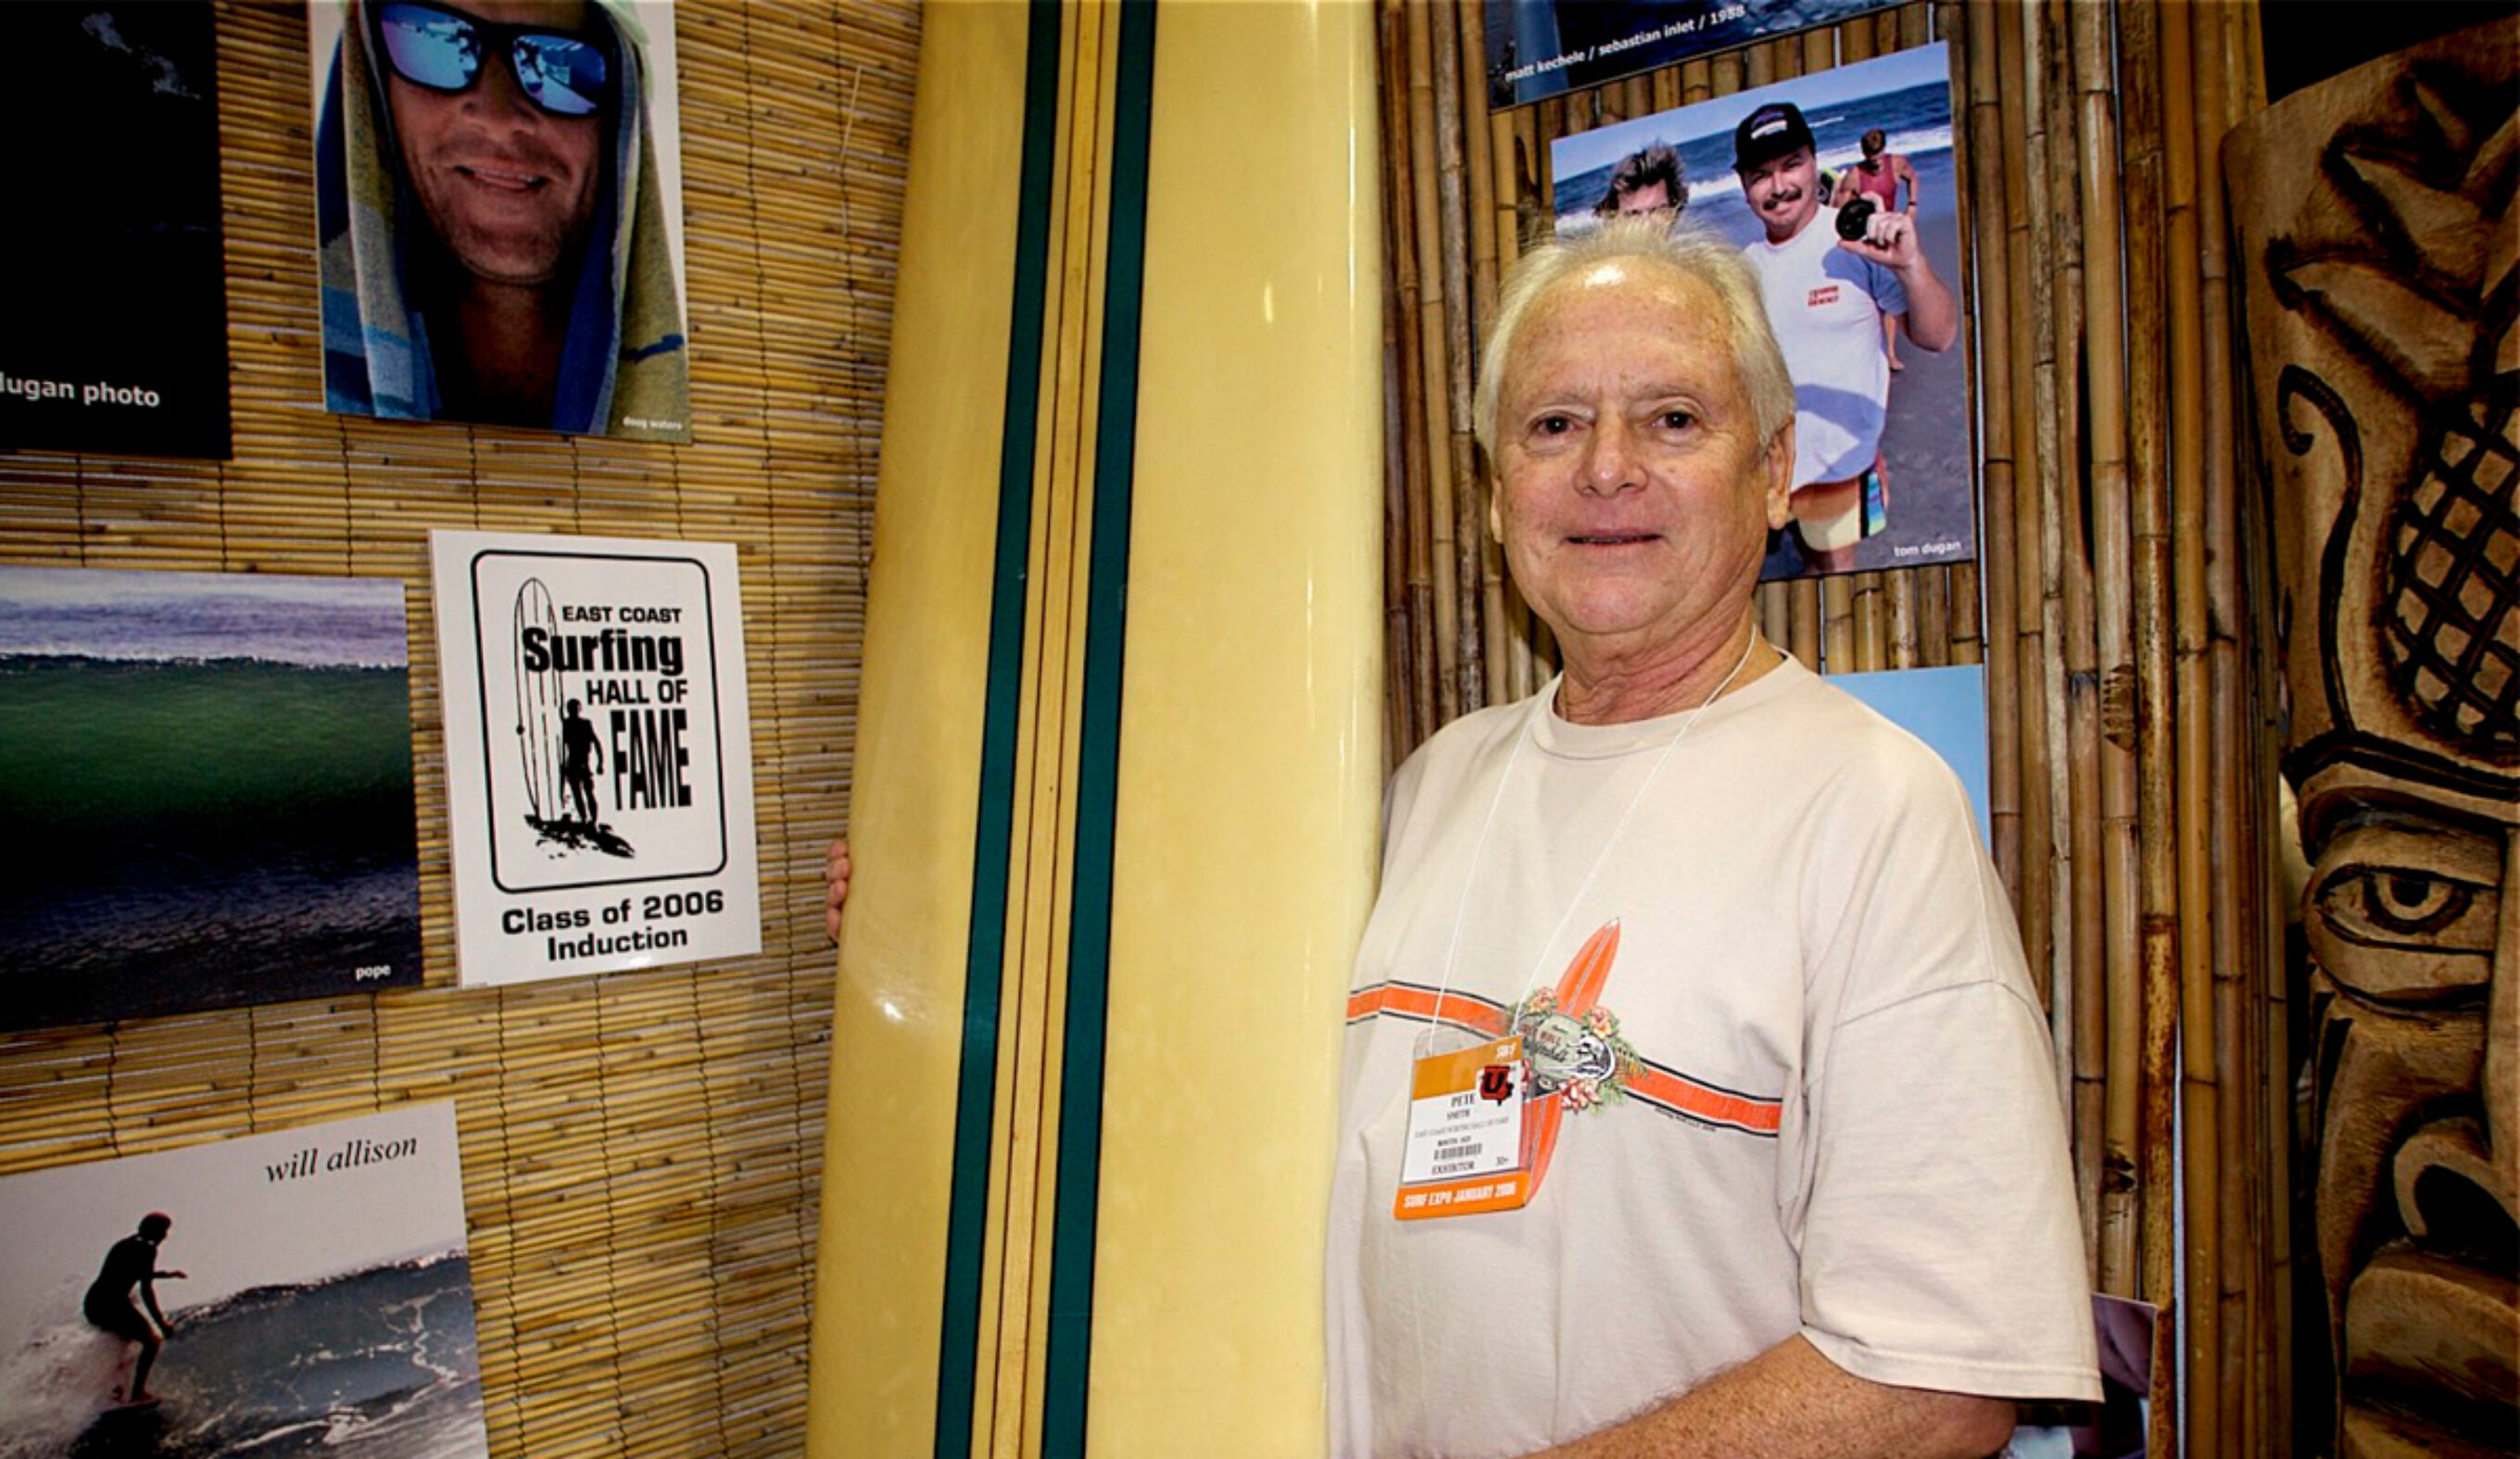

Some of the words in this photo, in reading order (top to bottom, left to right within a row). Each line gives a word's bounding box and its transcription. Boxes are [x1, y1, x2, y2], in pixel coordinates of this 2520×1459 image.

[1505, 65, 1535, 82] matt
[1536, 49, 1586, 72] kechele
[1598, 30, 1662, 57] sebastian
[1663, 19, 1695, 38] inlet
[82, 381, 161, 408] photo
[1921, 541, 1961, 555] dugan
[561, 606, 614, 623] EAST
[618, 607, 683, 623] COAST
[522, 626, 685, 677] Surfing
[586, 679, 650, 706] HALL
[656, 679, 688, 704] OF
[609, 709, 692, 811] FAME
[500, 907, 591, 936] Class
[600, 898, 632, 925] of
[642, 889, 724, 921] 2006
[547, 926, 688, 962] Induction
[355, 964, 392, 982] pope
[265, 1148, 319, 1183] will
[326, 1137, 418, 1173] allison
[1403, 1193, 1428, 1209] SURF
[1428, 1189, 1454, 1207] EXPO
[1452, 1184, 1495, 1204] JANUARY
